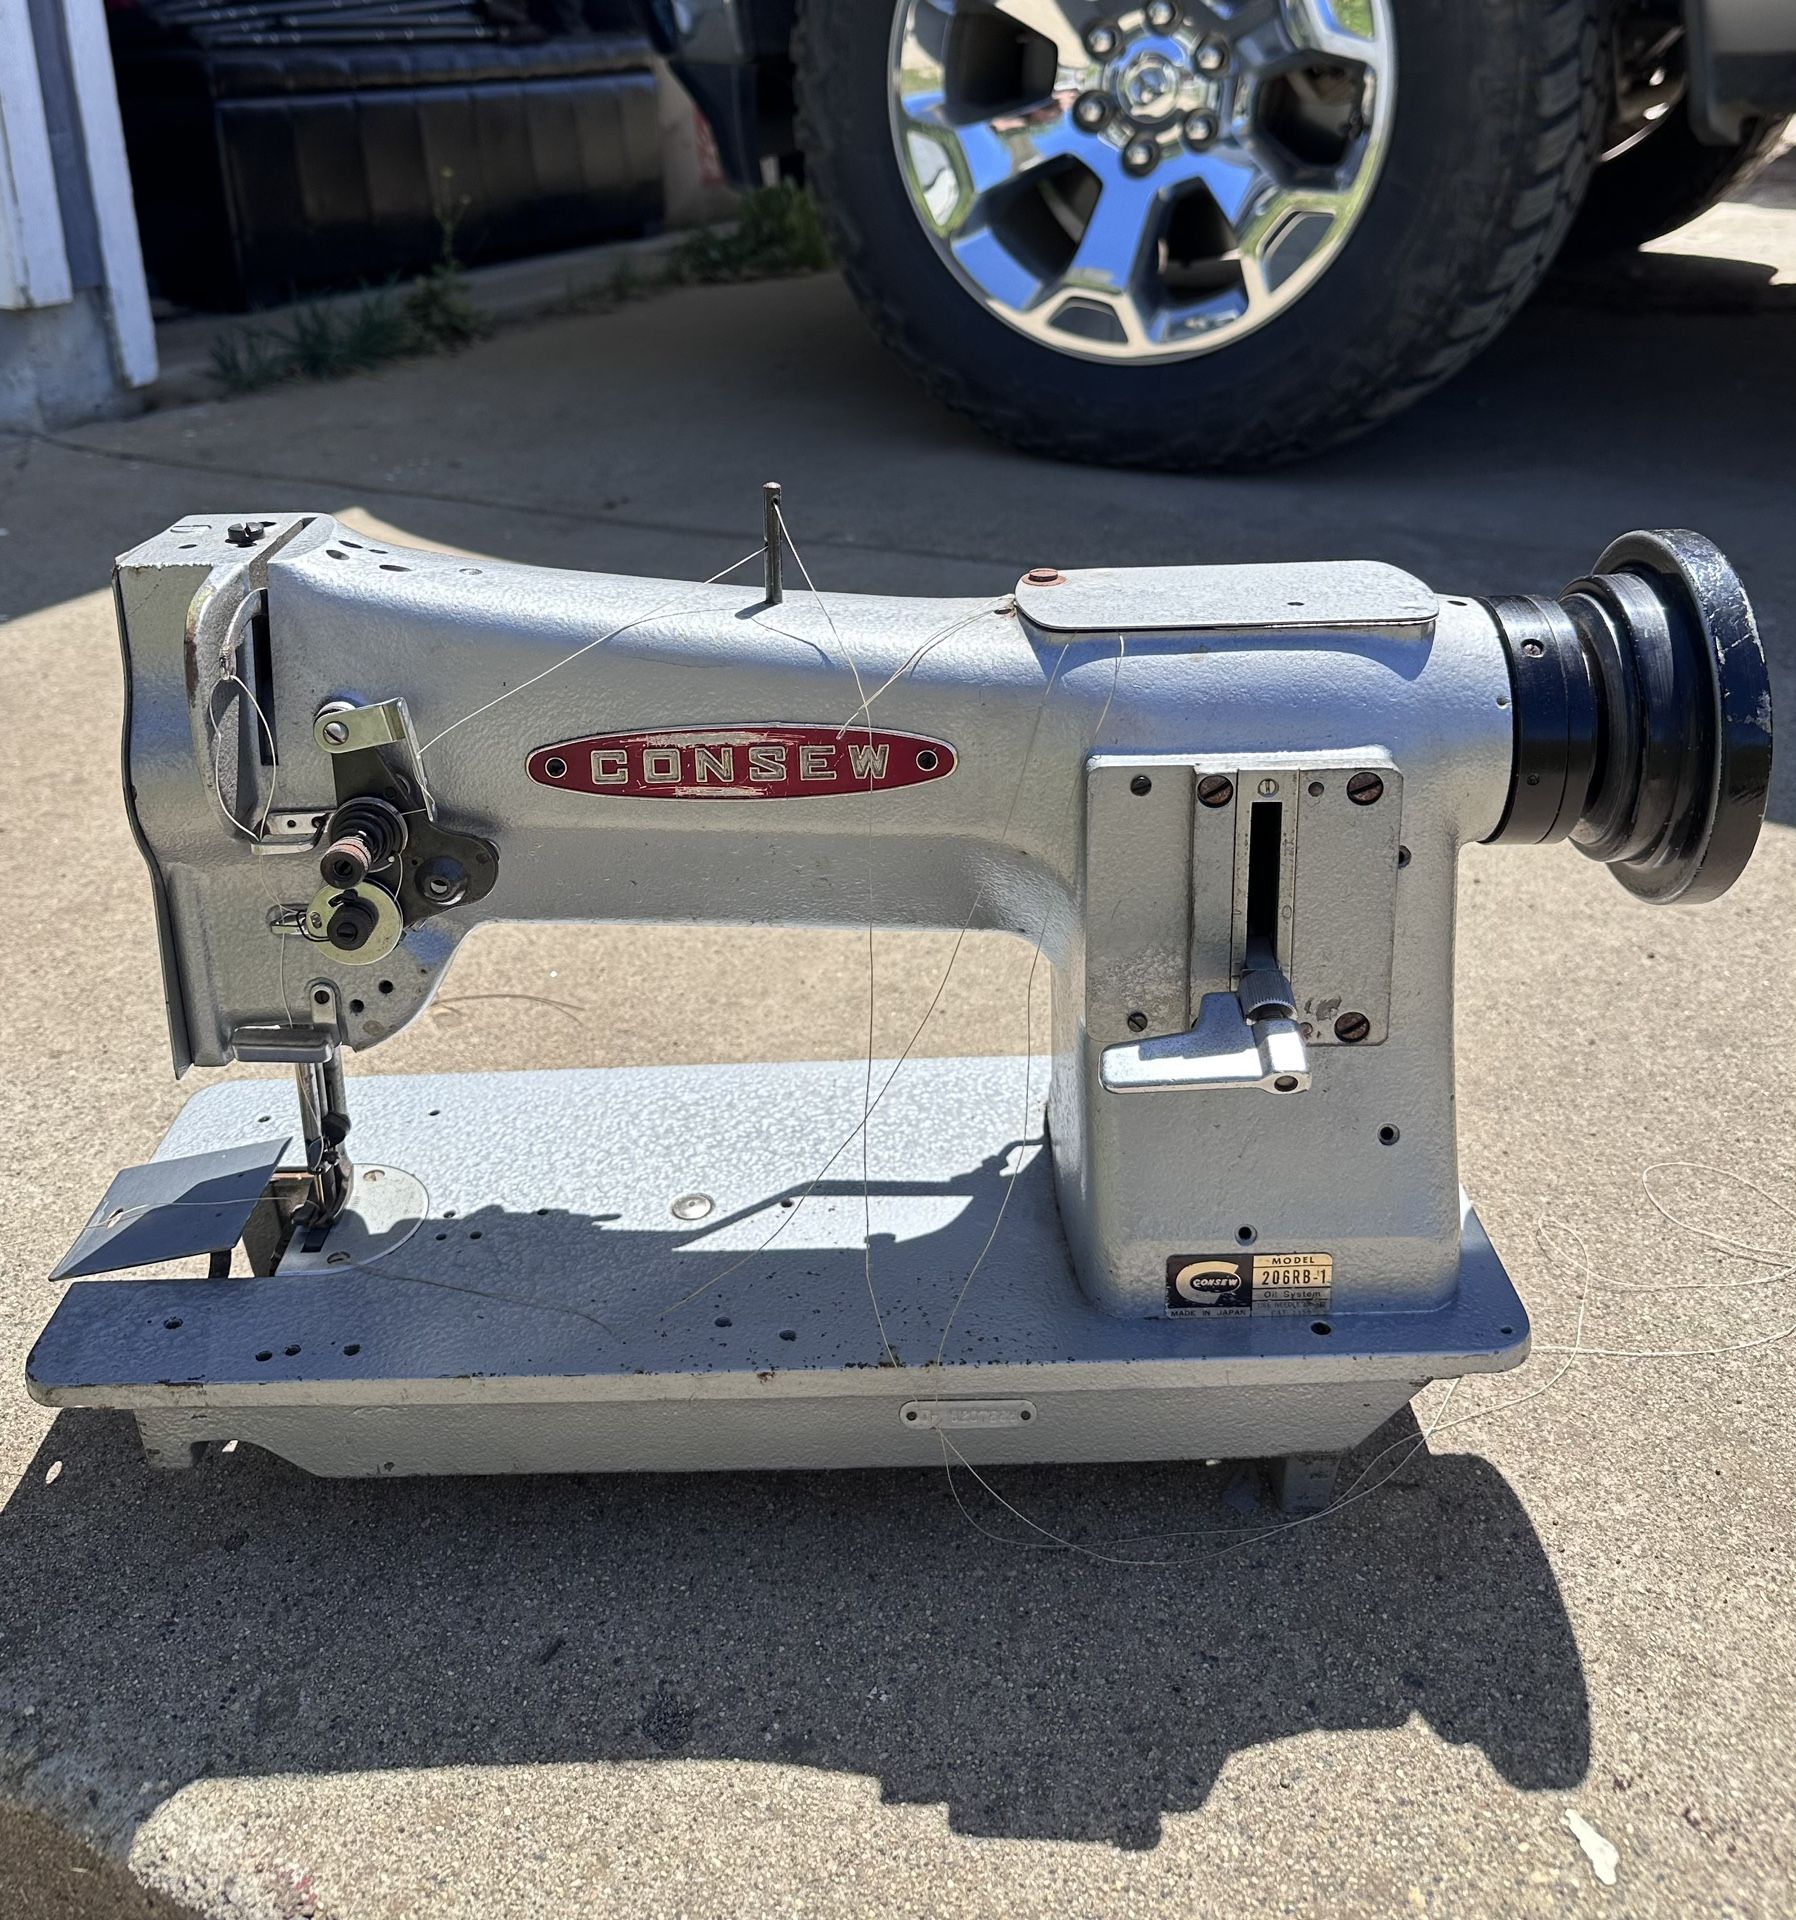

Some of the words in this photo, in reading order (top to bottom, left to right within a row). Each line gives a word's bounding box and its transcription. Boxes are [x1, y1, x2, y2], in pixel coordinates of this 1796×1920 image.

[590, 743, 890, 785] CONSEW
[1271, 1256, 1315, 1265] MODEL
[1261, 1269, 1327, 1286] 206RB-1
[1192, 1278, 1239, 1288] CONSEW
[1263, 1290, 1276, 1298] Oil
[1283, 1289, 1321, 1299] System
[1170, 1309, 1196, 1317] MADE
[1202, 1309, 1211, 1317] IN
[1217, 1309, 1246, 1317] JAPAN
